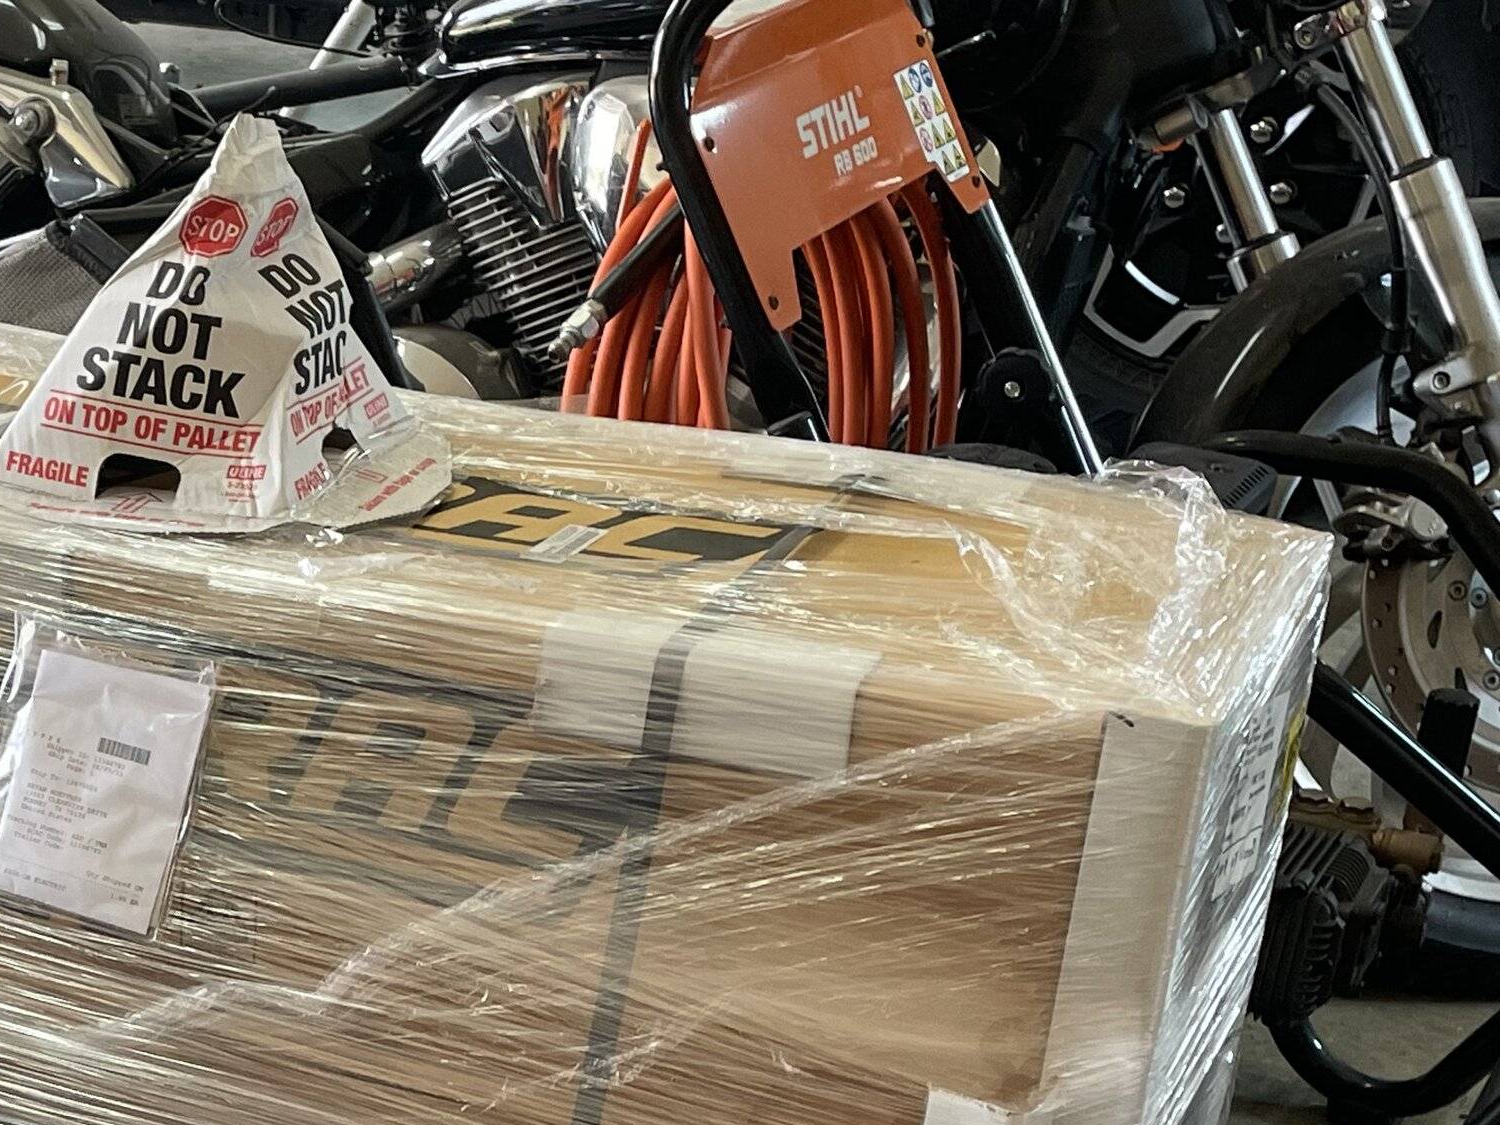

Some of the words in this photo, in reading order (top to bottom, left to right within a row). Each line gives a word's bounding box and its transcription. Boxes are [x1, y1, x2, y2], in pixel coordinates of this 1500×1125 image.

[796, 90, 870, 159] STIHL
[834, 149, 854, 175] RB
[188, 215, 239, 243] STOP
[146, 261, 211, 305] DO
[257, 253, 321, 299] DO
[117, 302, 223, 360] NOT
[284, 279, 346, 339] NOT
[77, 346, 246, 419] STACK
[294, 330, 347, 395] STAC
[44, 396, 76, 425] ON
[82, 404, 127, 434] TOP
[134, 415, 168, 442] OF
[172, 422, 261, 453] PALLET
[6, 450, 89, 487] FRAGILE
